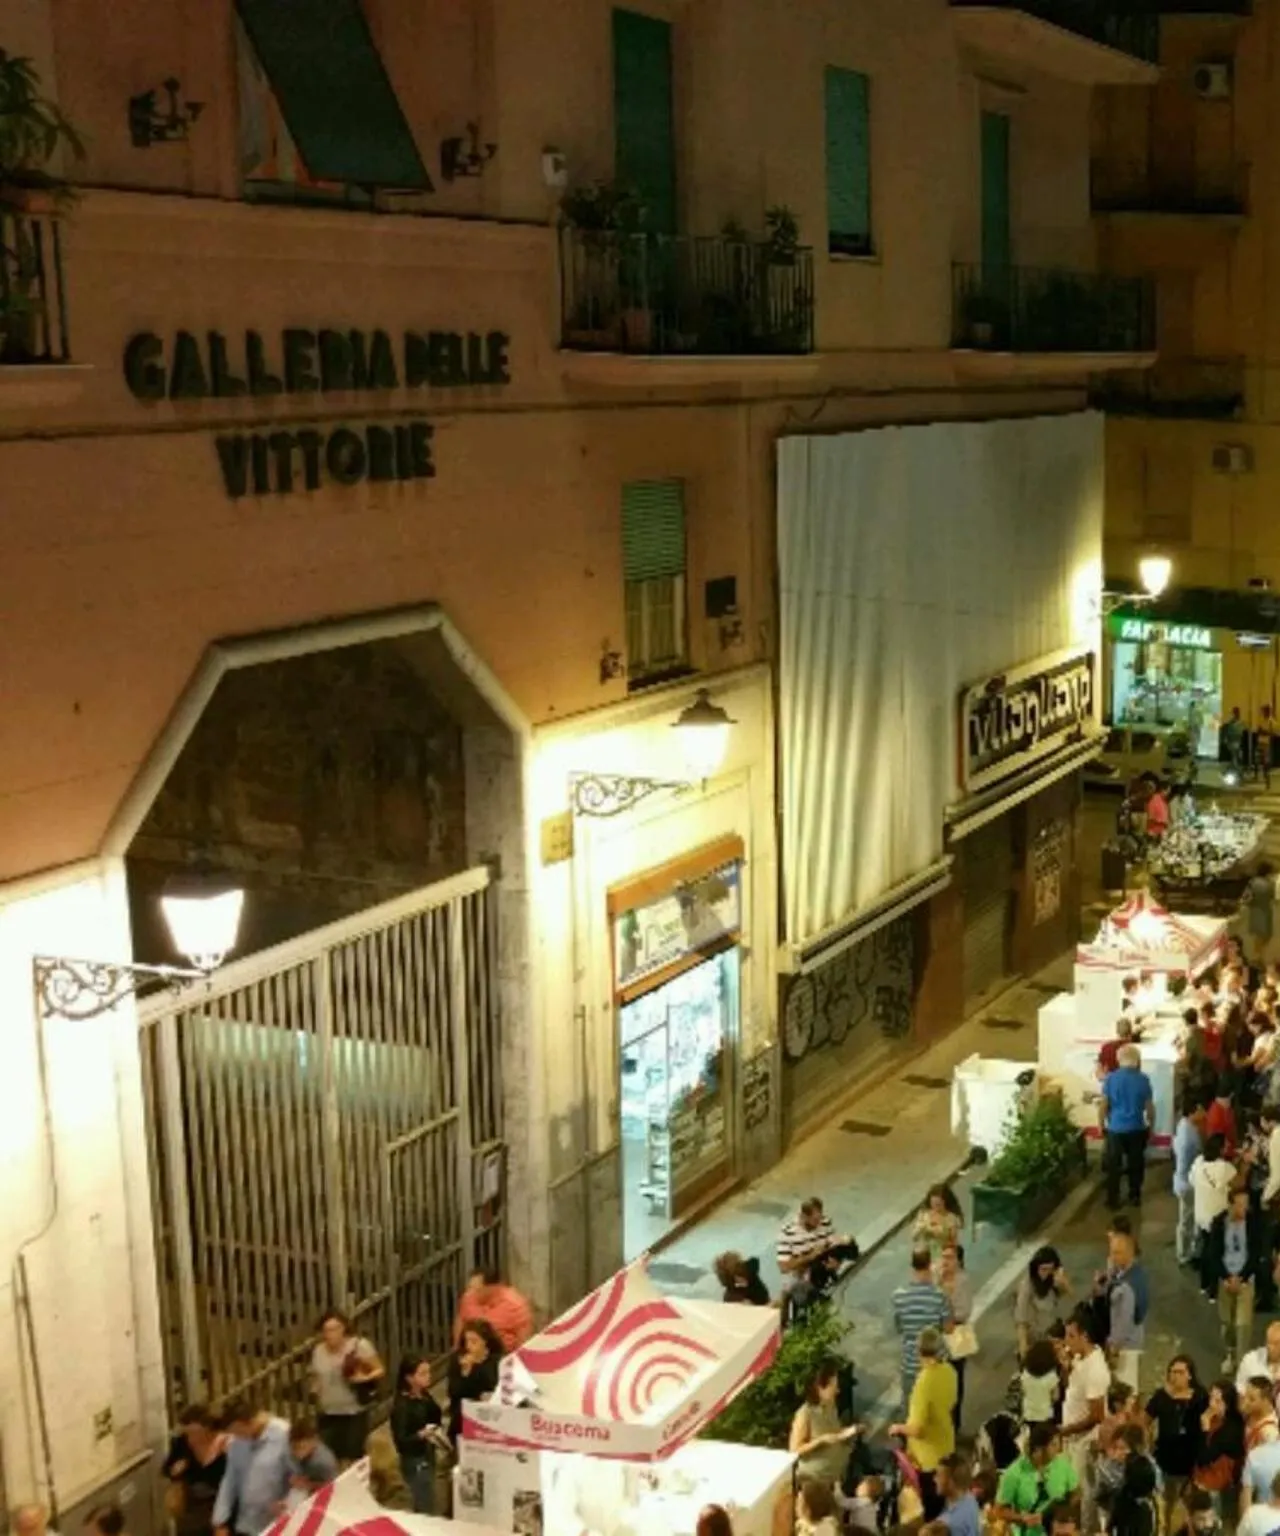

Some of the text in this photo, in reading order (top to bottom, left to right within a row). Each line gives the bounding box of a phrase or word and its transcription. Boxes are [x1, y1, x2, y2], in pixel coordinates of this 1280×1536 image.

[122, 328, 512, 400] GALLERIA DELLE
[213, 421, 437, 499] VITTORIE
